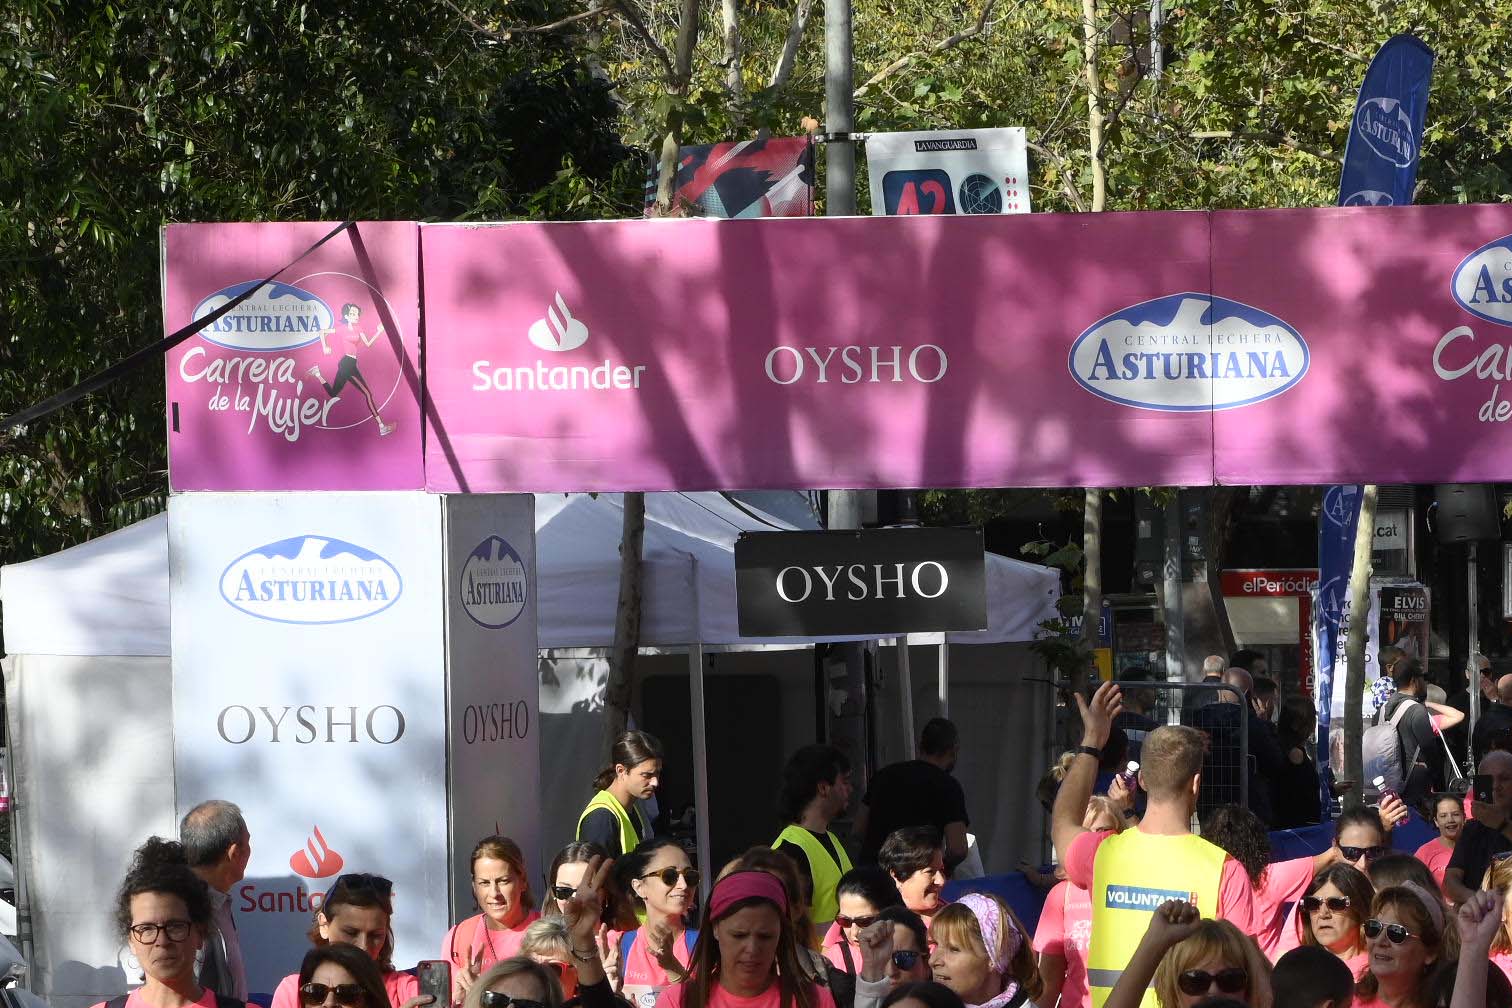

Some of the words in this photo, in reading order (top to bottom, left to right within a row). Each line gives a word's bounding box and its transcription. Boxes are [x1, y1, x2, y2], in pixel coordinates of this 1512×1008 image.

[230, 303, 269, 312] ENTRAL
[1123, 333, 1201, 346] CENTRAL
[179, 346, 296, 384] Carrera
[471, 359, 646, 391] Santander
[764, 343, 949, 386] OYSHO
[1087, 337, 1291, 382] ASTURIANA
[208, 385, 230, 411] de
[234, 385, 251, 412] la
[248, 380, 341, 442] Mujer
[1478, 384, 1512, 423] de
[234, 567, 390, 602] ASTURIANA
[465, 571, 524, 607] ASTURIANA
[775, 560, 950, 604] OYSHO
[1394, 596, 1425, 610] ELVIS
[216, 704, 406, 745] OYSHO
[463, 700, 529, 745] OYSHO
